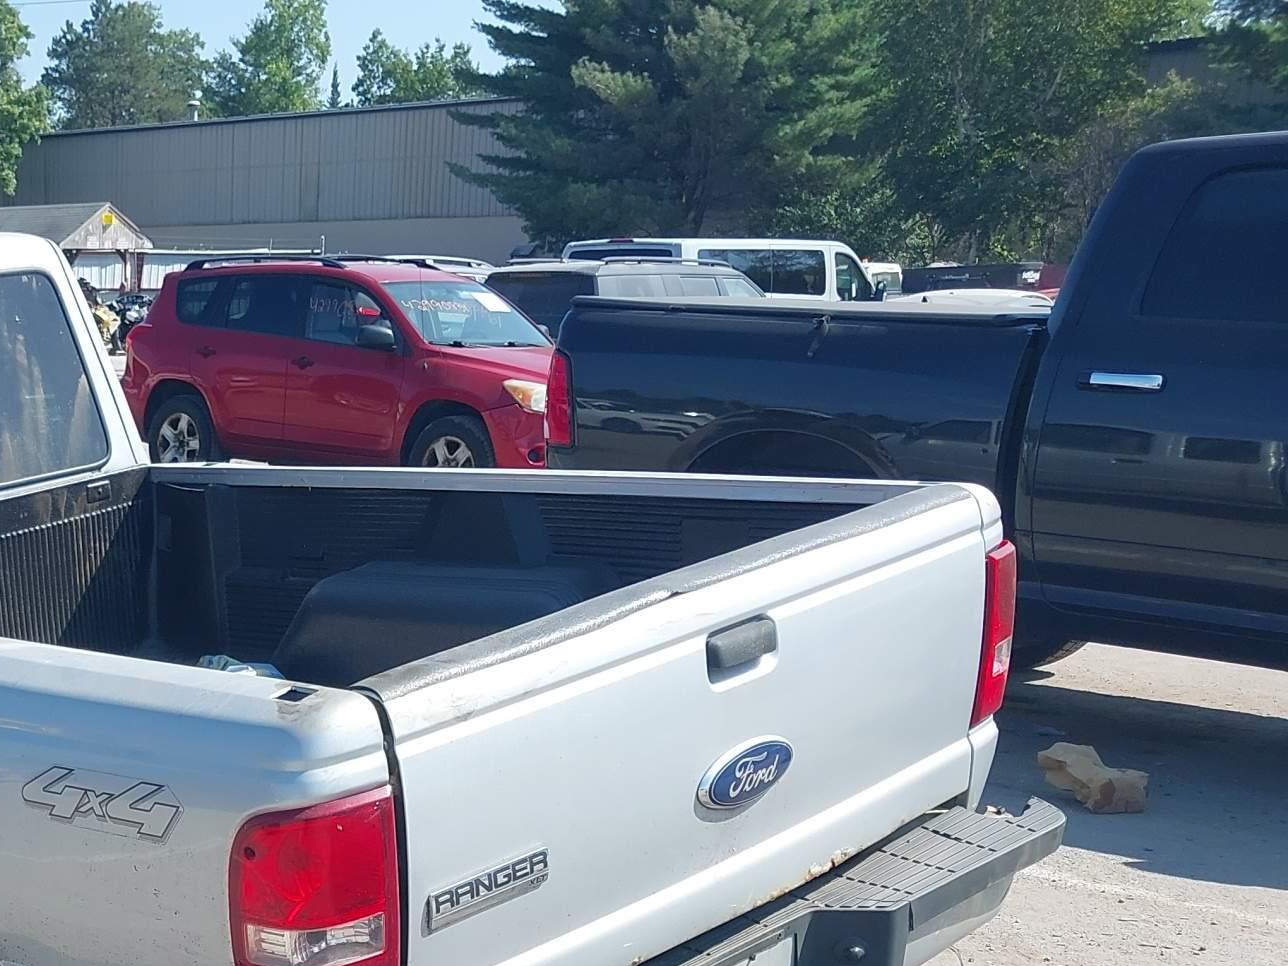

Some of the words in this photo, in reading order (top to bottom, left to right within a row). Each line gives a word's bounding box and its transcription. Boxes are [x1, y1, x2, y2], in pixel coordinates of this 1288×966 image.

[21, 766, 180, 839] 4x4
[729, 751, 779, 798] Ford
[433, 851, 549, 914] RANGER
